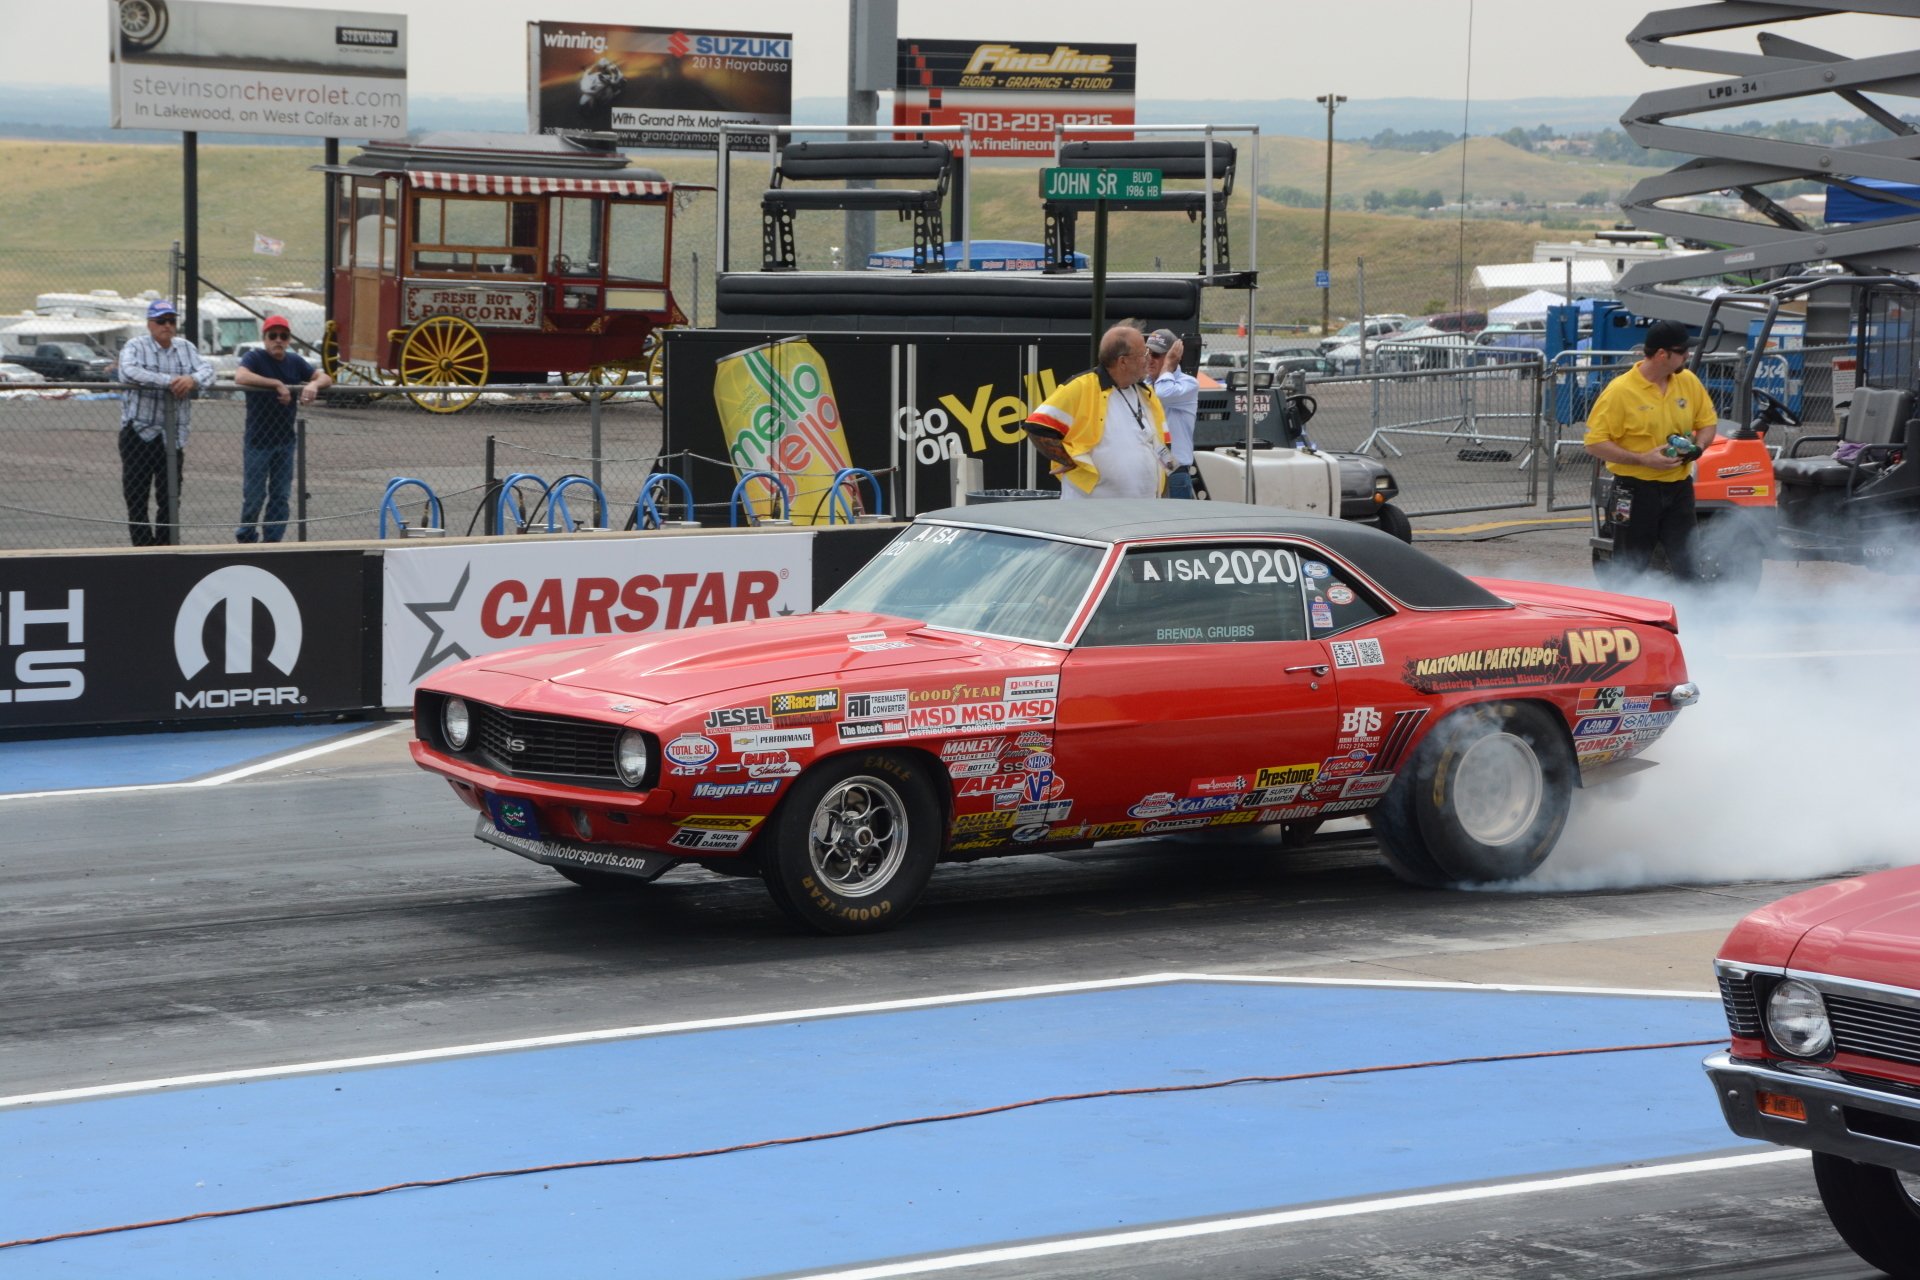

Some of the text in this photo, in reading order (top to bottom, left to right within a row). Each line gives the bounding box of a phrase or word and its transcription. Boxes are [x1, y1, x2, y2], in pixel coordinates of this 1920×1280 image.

[341, 29, 394, 44] STEVINSON
[695, 36, 790, 58] SUZUKI
[691, 56, 788, 74] 2013 Hayabusa
[959, 76, 1113, 89] SIGNS GRAPHICS STUDIO
[132, 76, 401, 108] stevinsonchevrolet.com
[135, 103, 149, 116] In
[239, 109, 258, 122] on
[262, 109, 300, 124] West
[304, 110, 350, 127] Colfax
[354, 114, 368, 127] at
[371, 115, 401, 129] I-70
[612, 112, 635, 125] With
[638, 113, 675, 127] Grand
[677, 114, 695, 127] Prix
[1048, 172, 1118, 195] JOHN SR
[1132, 171, 1153, 183] BLVD
[1126, 185, 1145, 197] 1986
[433, 292, 513, 305] FRESH HOT
[421, 304, 522, 320] POPCORN
[1234, 395, 1272, 404] SAETY
[730, 350, 821, 476] mello
[1234, 403, 1271, 412] SAARI
[893, 405, 949, 441] Go
[916, 431, 964, 465] on
[1208, 549, 1297, 585] 2020
[480, 569, 780, 639] CARSTAR
[1156, 625, 1255, 641] BRENDA GRUBBS
[1566, 627, 1641, 665] NPD
[1416, 646, 1559, 676] NATIONAL PARTS DEPOT
[788, 691, 837, 711] Racepak
[847, 695, 871, 717] ATI
[871, 694, 907, 704] TREEMASTER
[872, 704, 906, 714] CONVERTER
[910, 700, 1055, 727] MSD MSD MSD
[705, 708, 769, 728] JESEL
[1341, 707, 1382, 737] BTS
[1583, 719, 1612, 730] LAMB
[842, 726, 855, 736] The
[856, 723, 884, 735] Racer's
[909, 726, 957, 737] DISTRIBUTOR
[961, 723, 1007, 733] CONDUCTOR
[760, 733, 812, 744] PERFORMANCE
[1577, 737, 1617, 752] COMP
[670, 744, 712, 756] TOTAL SEAL
[943, 739, 998, 754] MANLEY
[1003, 763, 1025, 772] SS
[1028, 756, 1050, 769] NHRA
[1325, 761, 1352, 771] LUCAS
[670, 765, 708, 776] 427
[1257, 767, 1315, 787] Prestone
[960, 774, 1026, 794] ARP
[1026, 769, 1054, 802] VP
[1269, 787, 1295, 795] SUPER
[1262, 794, 1295, 804] DAMPER
[1319, 797, 1379, 813] MOROSO
[1019, 803, 1039, 812] CREW
[1257, 806, 1319, 822] Autolite
[1219, 810, 1259, 824] JEGS
[710, 833, 739, 841] SUPER
